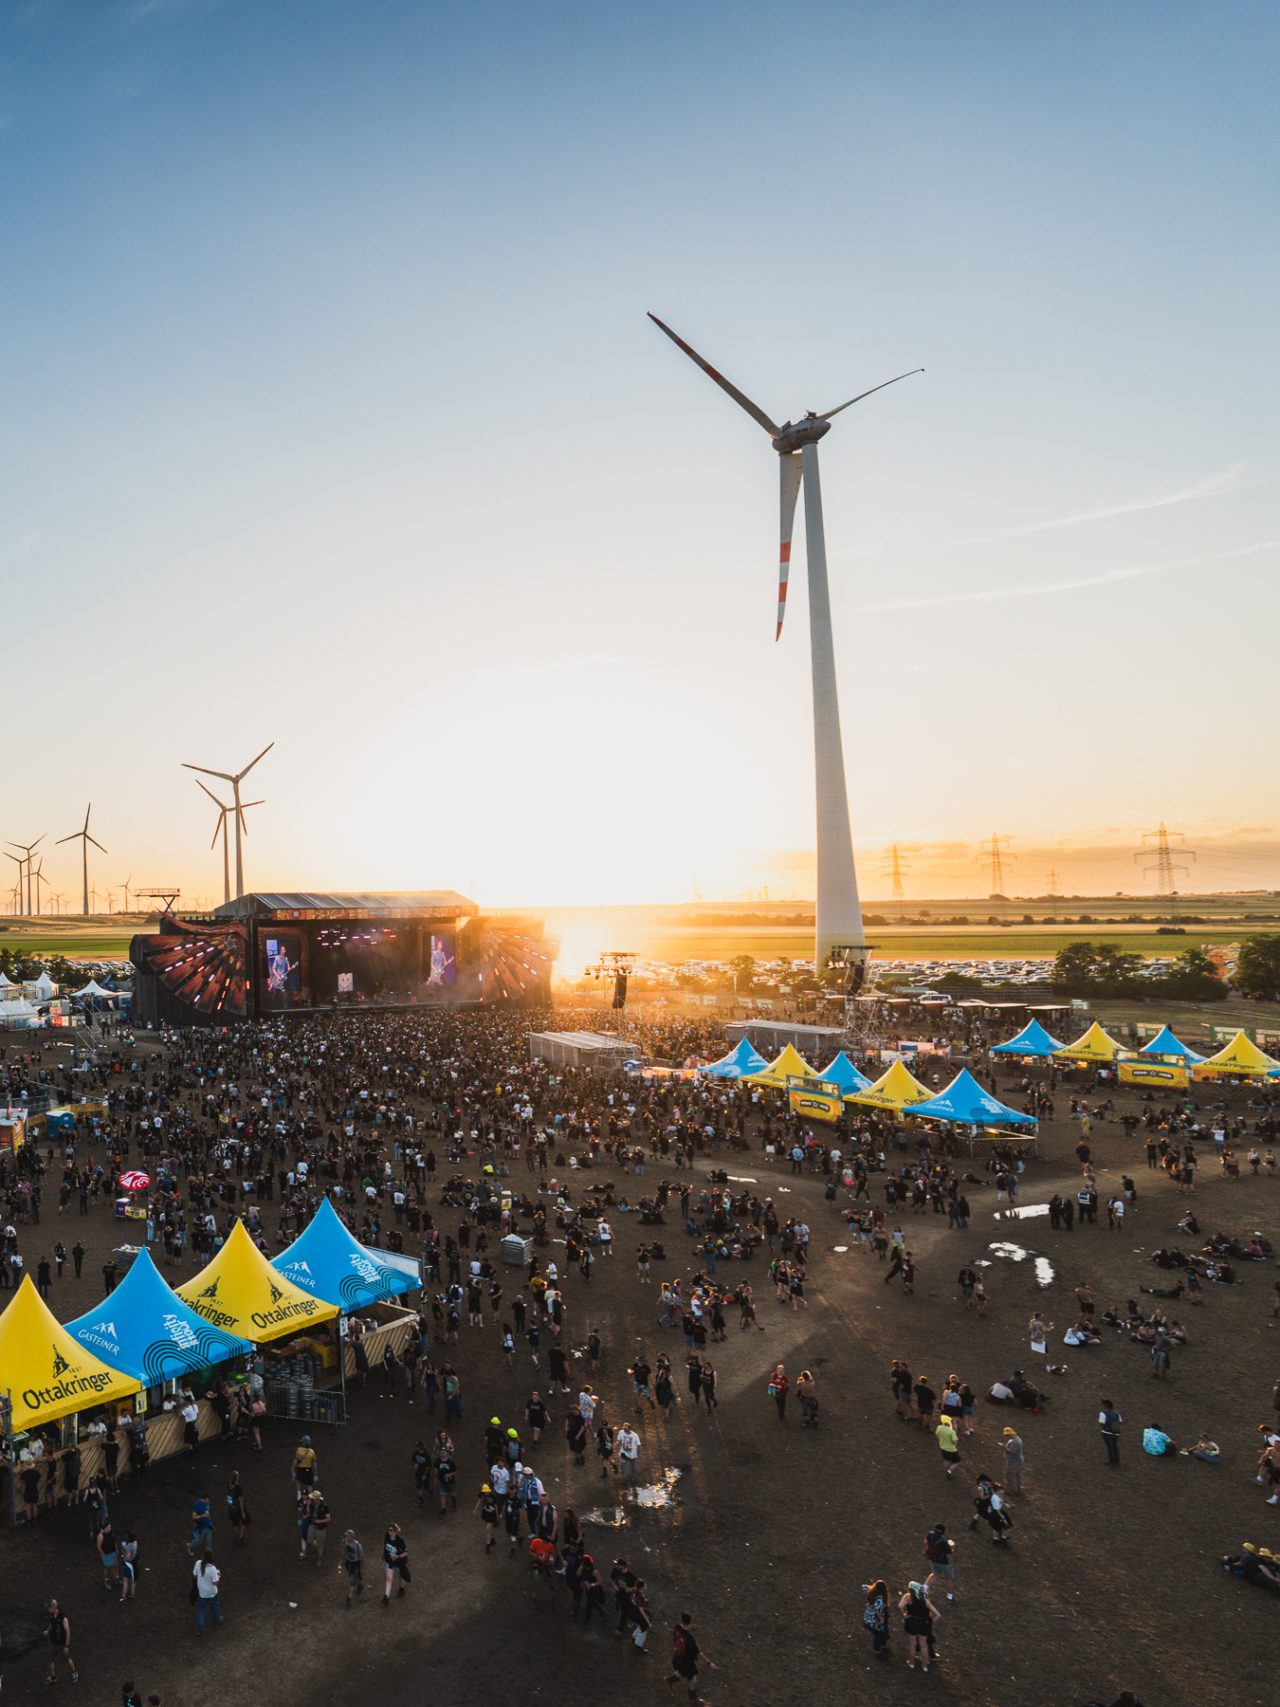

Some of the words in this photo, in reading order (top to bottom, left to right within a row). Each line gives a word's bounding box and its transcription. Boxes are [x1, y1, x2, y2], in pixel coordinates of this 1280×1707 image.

[275, 1268, 316, 1288] STEINER
[175, 1292, 240, 1328] takringer
[251, 1299, 320, 1330] Ottakringer
[78, 1329, 120, 1356] GASTEINER
[22, 1371, 114, 1410] Ottakringer
